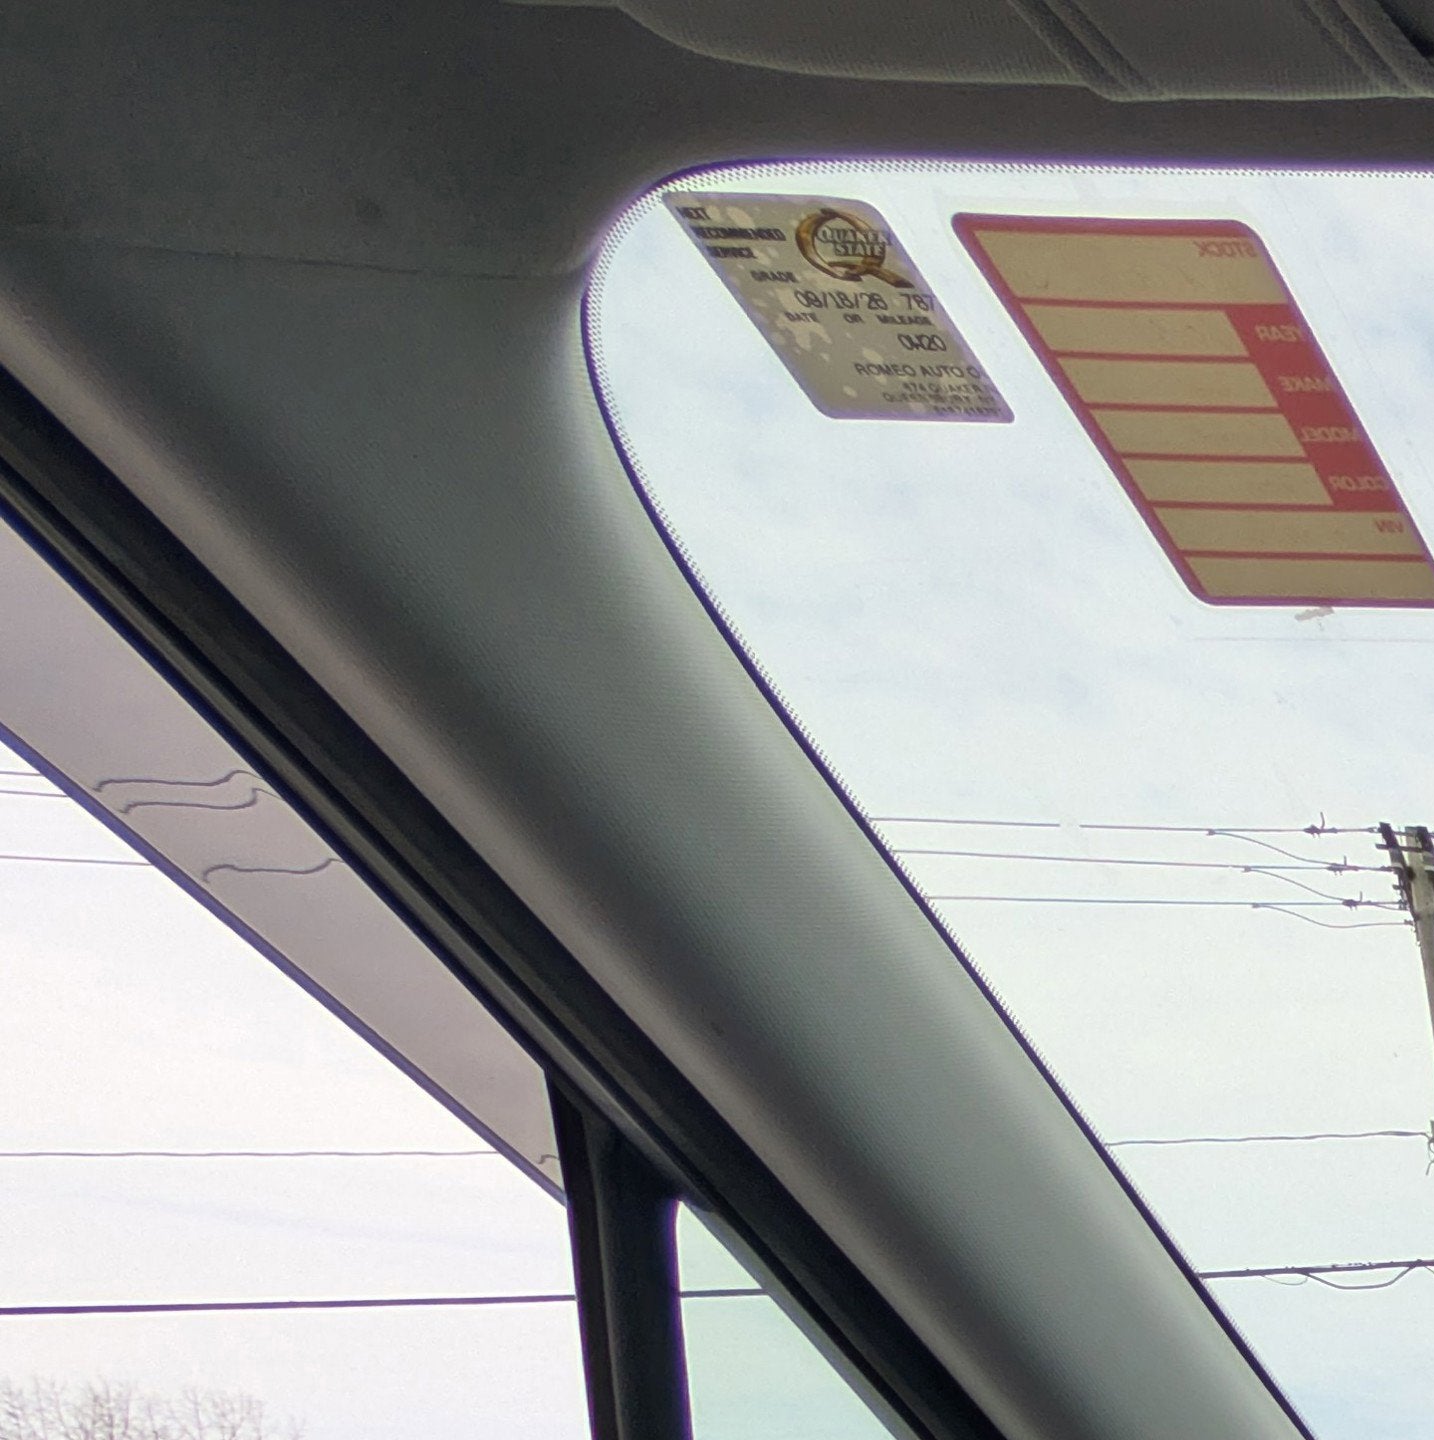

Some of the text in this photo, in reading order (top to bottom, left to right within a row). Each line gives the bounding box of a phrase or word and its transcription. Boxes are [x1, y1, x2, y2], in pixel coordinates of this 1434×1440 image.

[676, 206, 711, 220] NEXT
[834, 240, 886, 257] STATE
[750, 270, 799, 283] GRADE
[854, 363, 916, 377] ROMEO
[920, 365, 964, 378] AUTO
